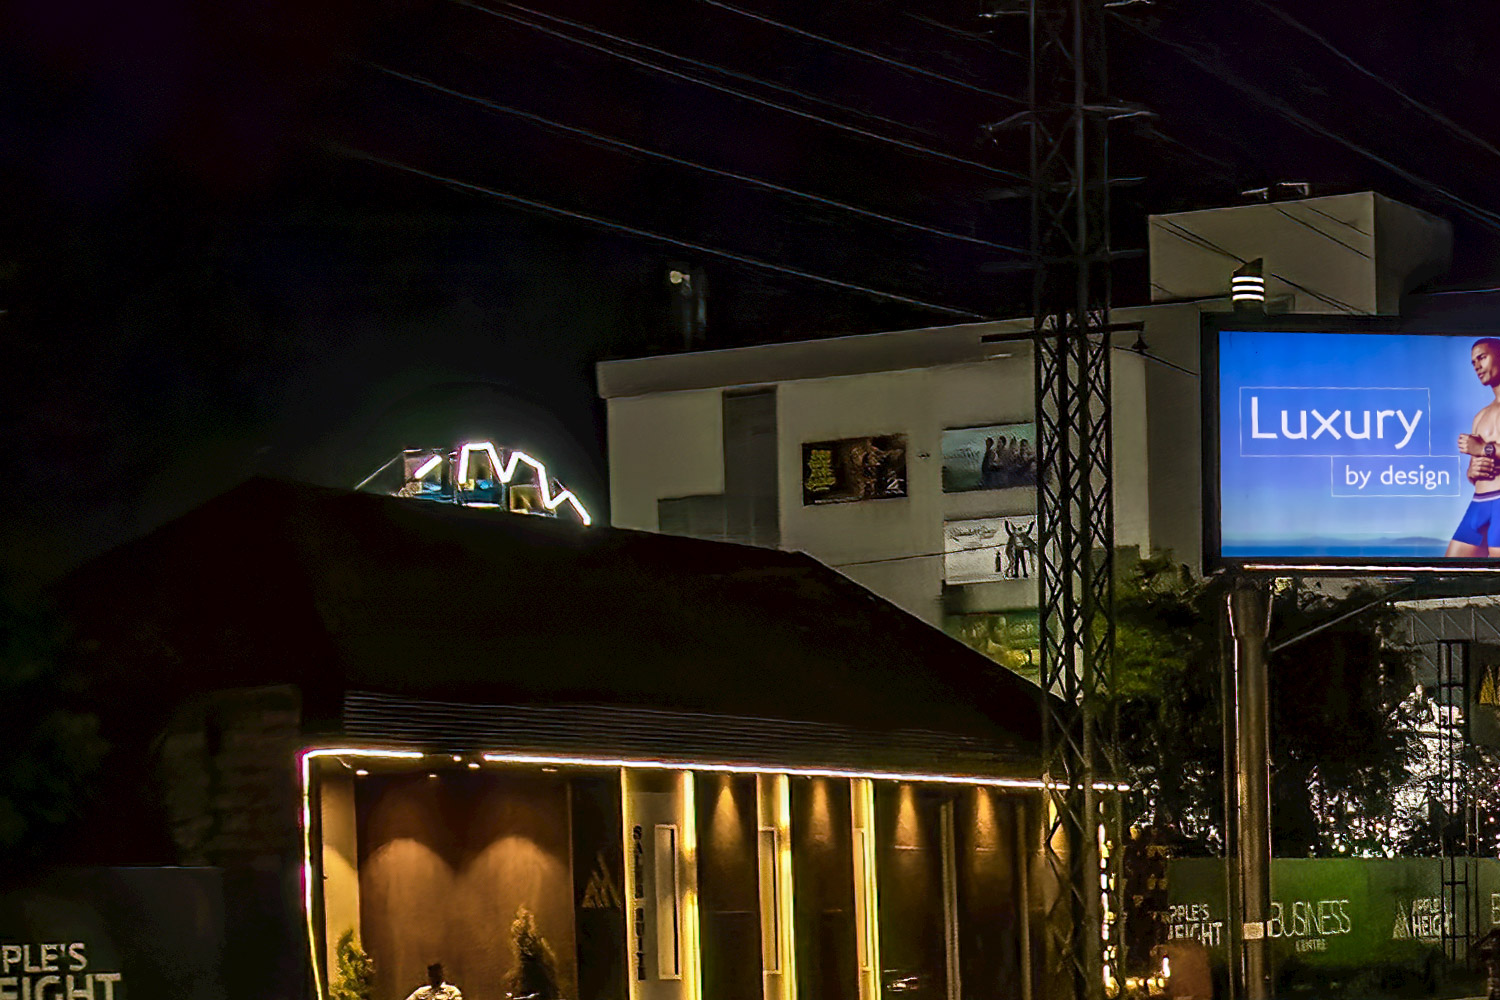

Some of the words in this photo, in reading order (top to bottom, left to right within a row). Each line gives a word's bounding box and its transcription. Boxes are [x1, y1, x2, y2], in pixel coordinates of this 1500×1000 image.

[1251, 396, 1423, 450] Luxury
[1345, 465, 1372, 490] by
[1380, 465, 1450, 490] design
